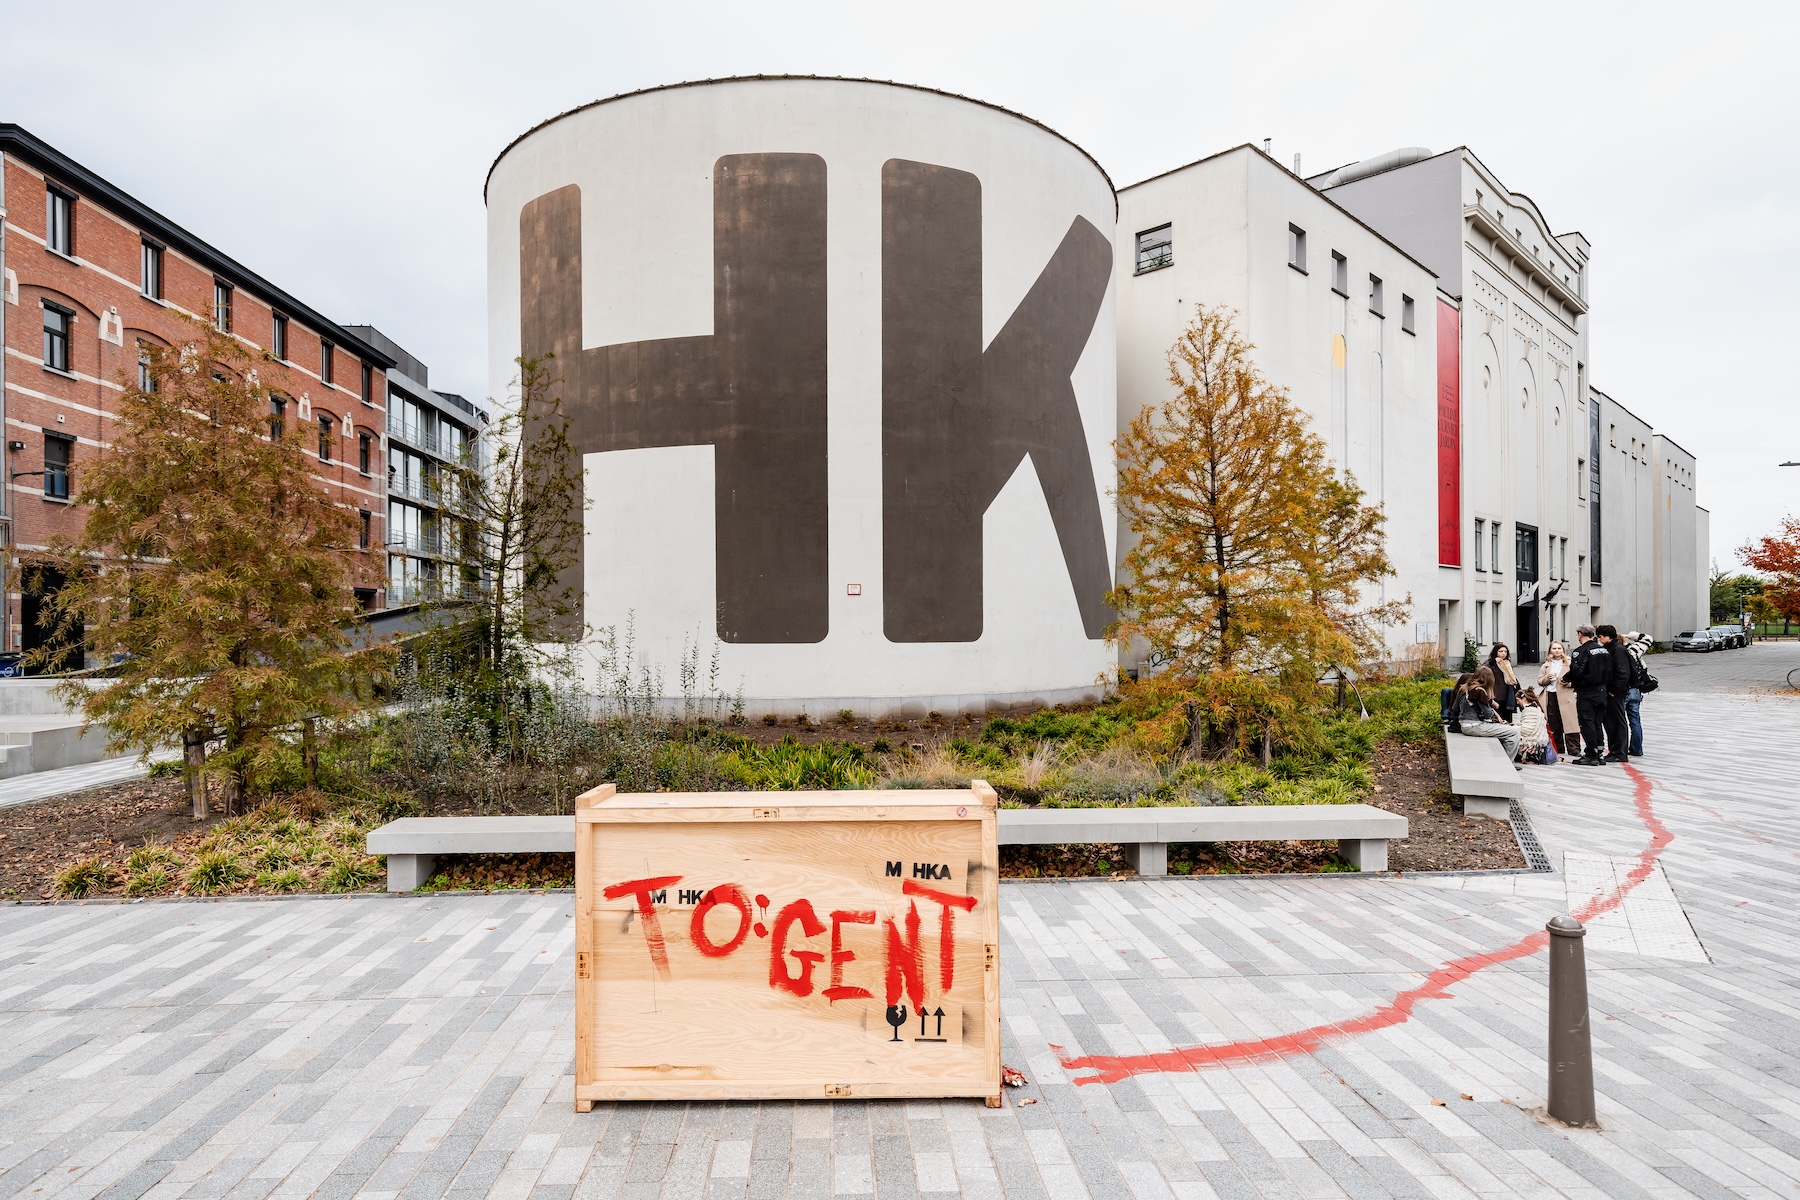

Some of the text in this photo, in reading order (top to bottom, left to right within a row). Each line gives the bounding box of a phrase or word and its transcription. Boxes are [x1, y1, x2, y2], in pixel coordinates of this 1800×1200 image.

[886, 861, 952, 880] M HKA
[651, 889, 667, 904] M
